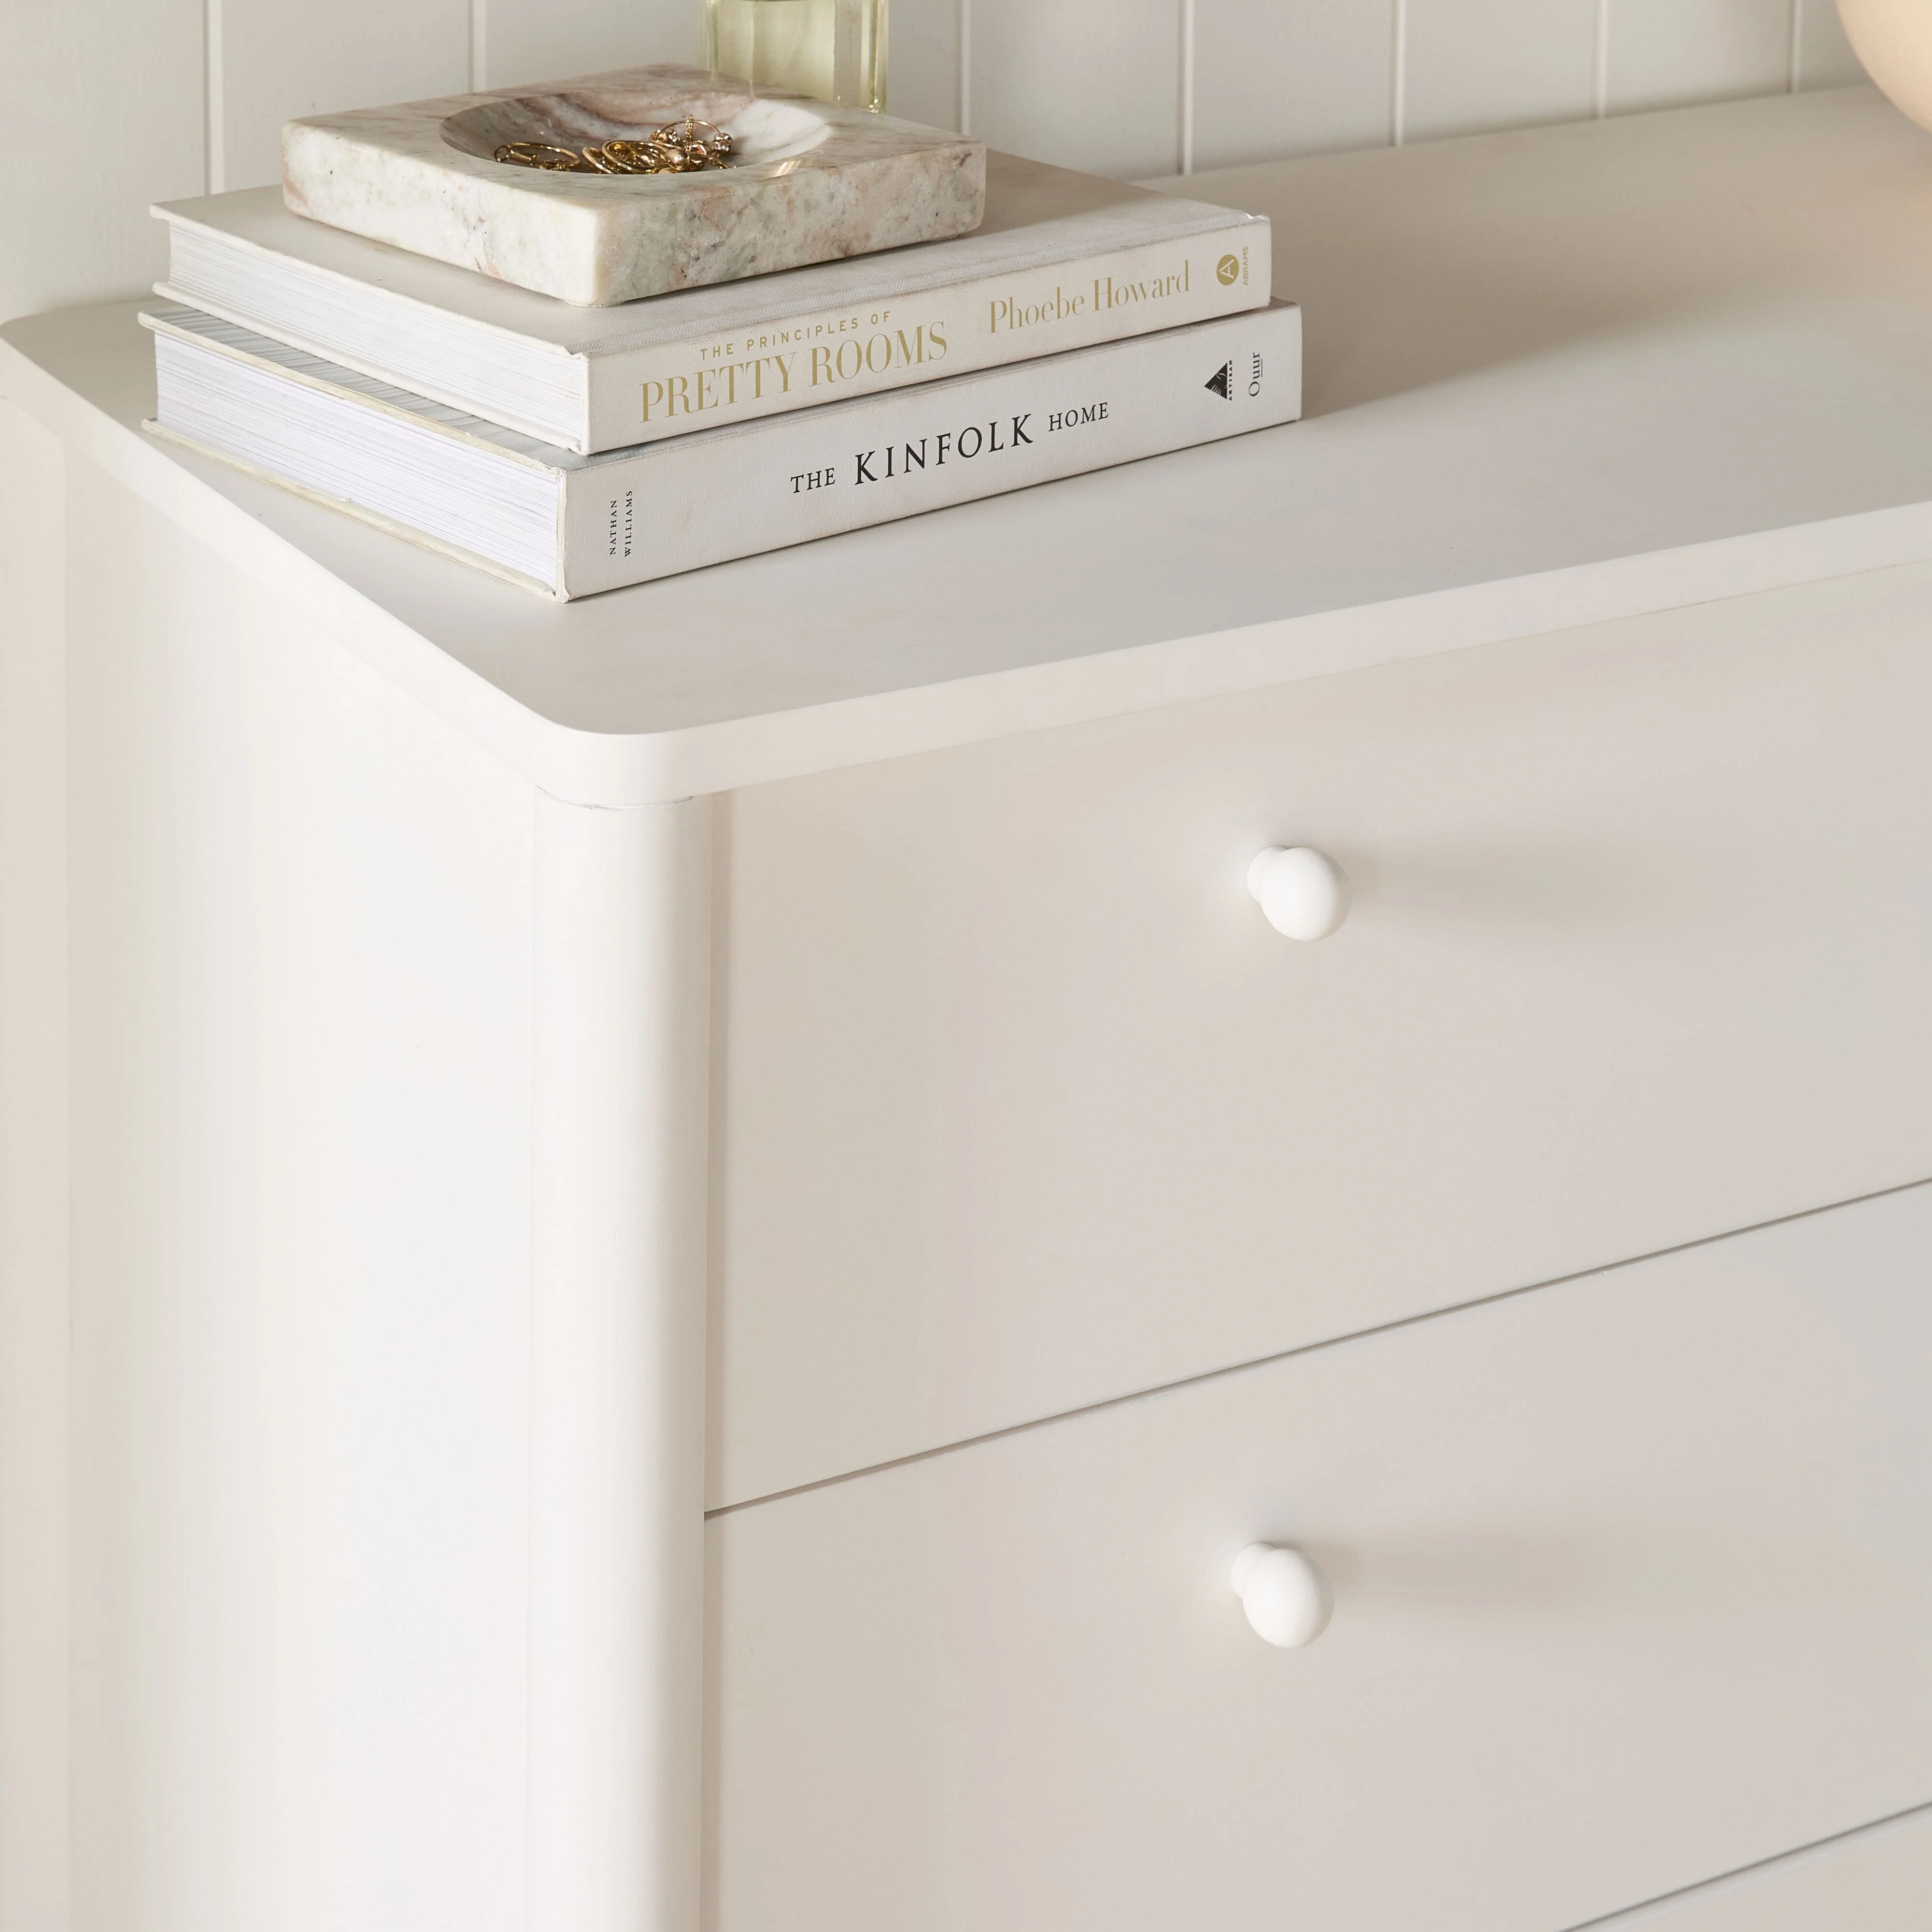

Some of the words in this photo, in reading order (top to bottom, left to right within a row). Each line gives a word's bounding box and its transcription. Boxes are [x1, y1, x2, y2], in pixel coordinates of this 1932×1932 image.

[989, 287, 1085, 334] Phoebe
[1092, 260, 1190, 312] Howard
[639, 352, 797, 423] PRETTY
[808, 321, 947, 386] ROOMS
[700, 343, 734, 360] THE
[746, 318, 859, 351] PRINCIPLES
[871, 311, 891, 325] OF
[1249, 352, 1260, 397] Ouur
[790, 467, 836, 494] THE
[854, 413, 1033, 485] KINFOLK
[1048, 402, 1109, 432] HOME
